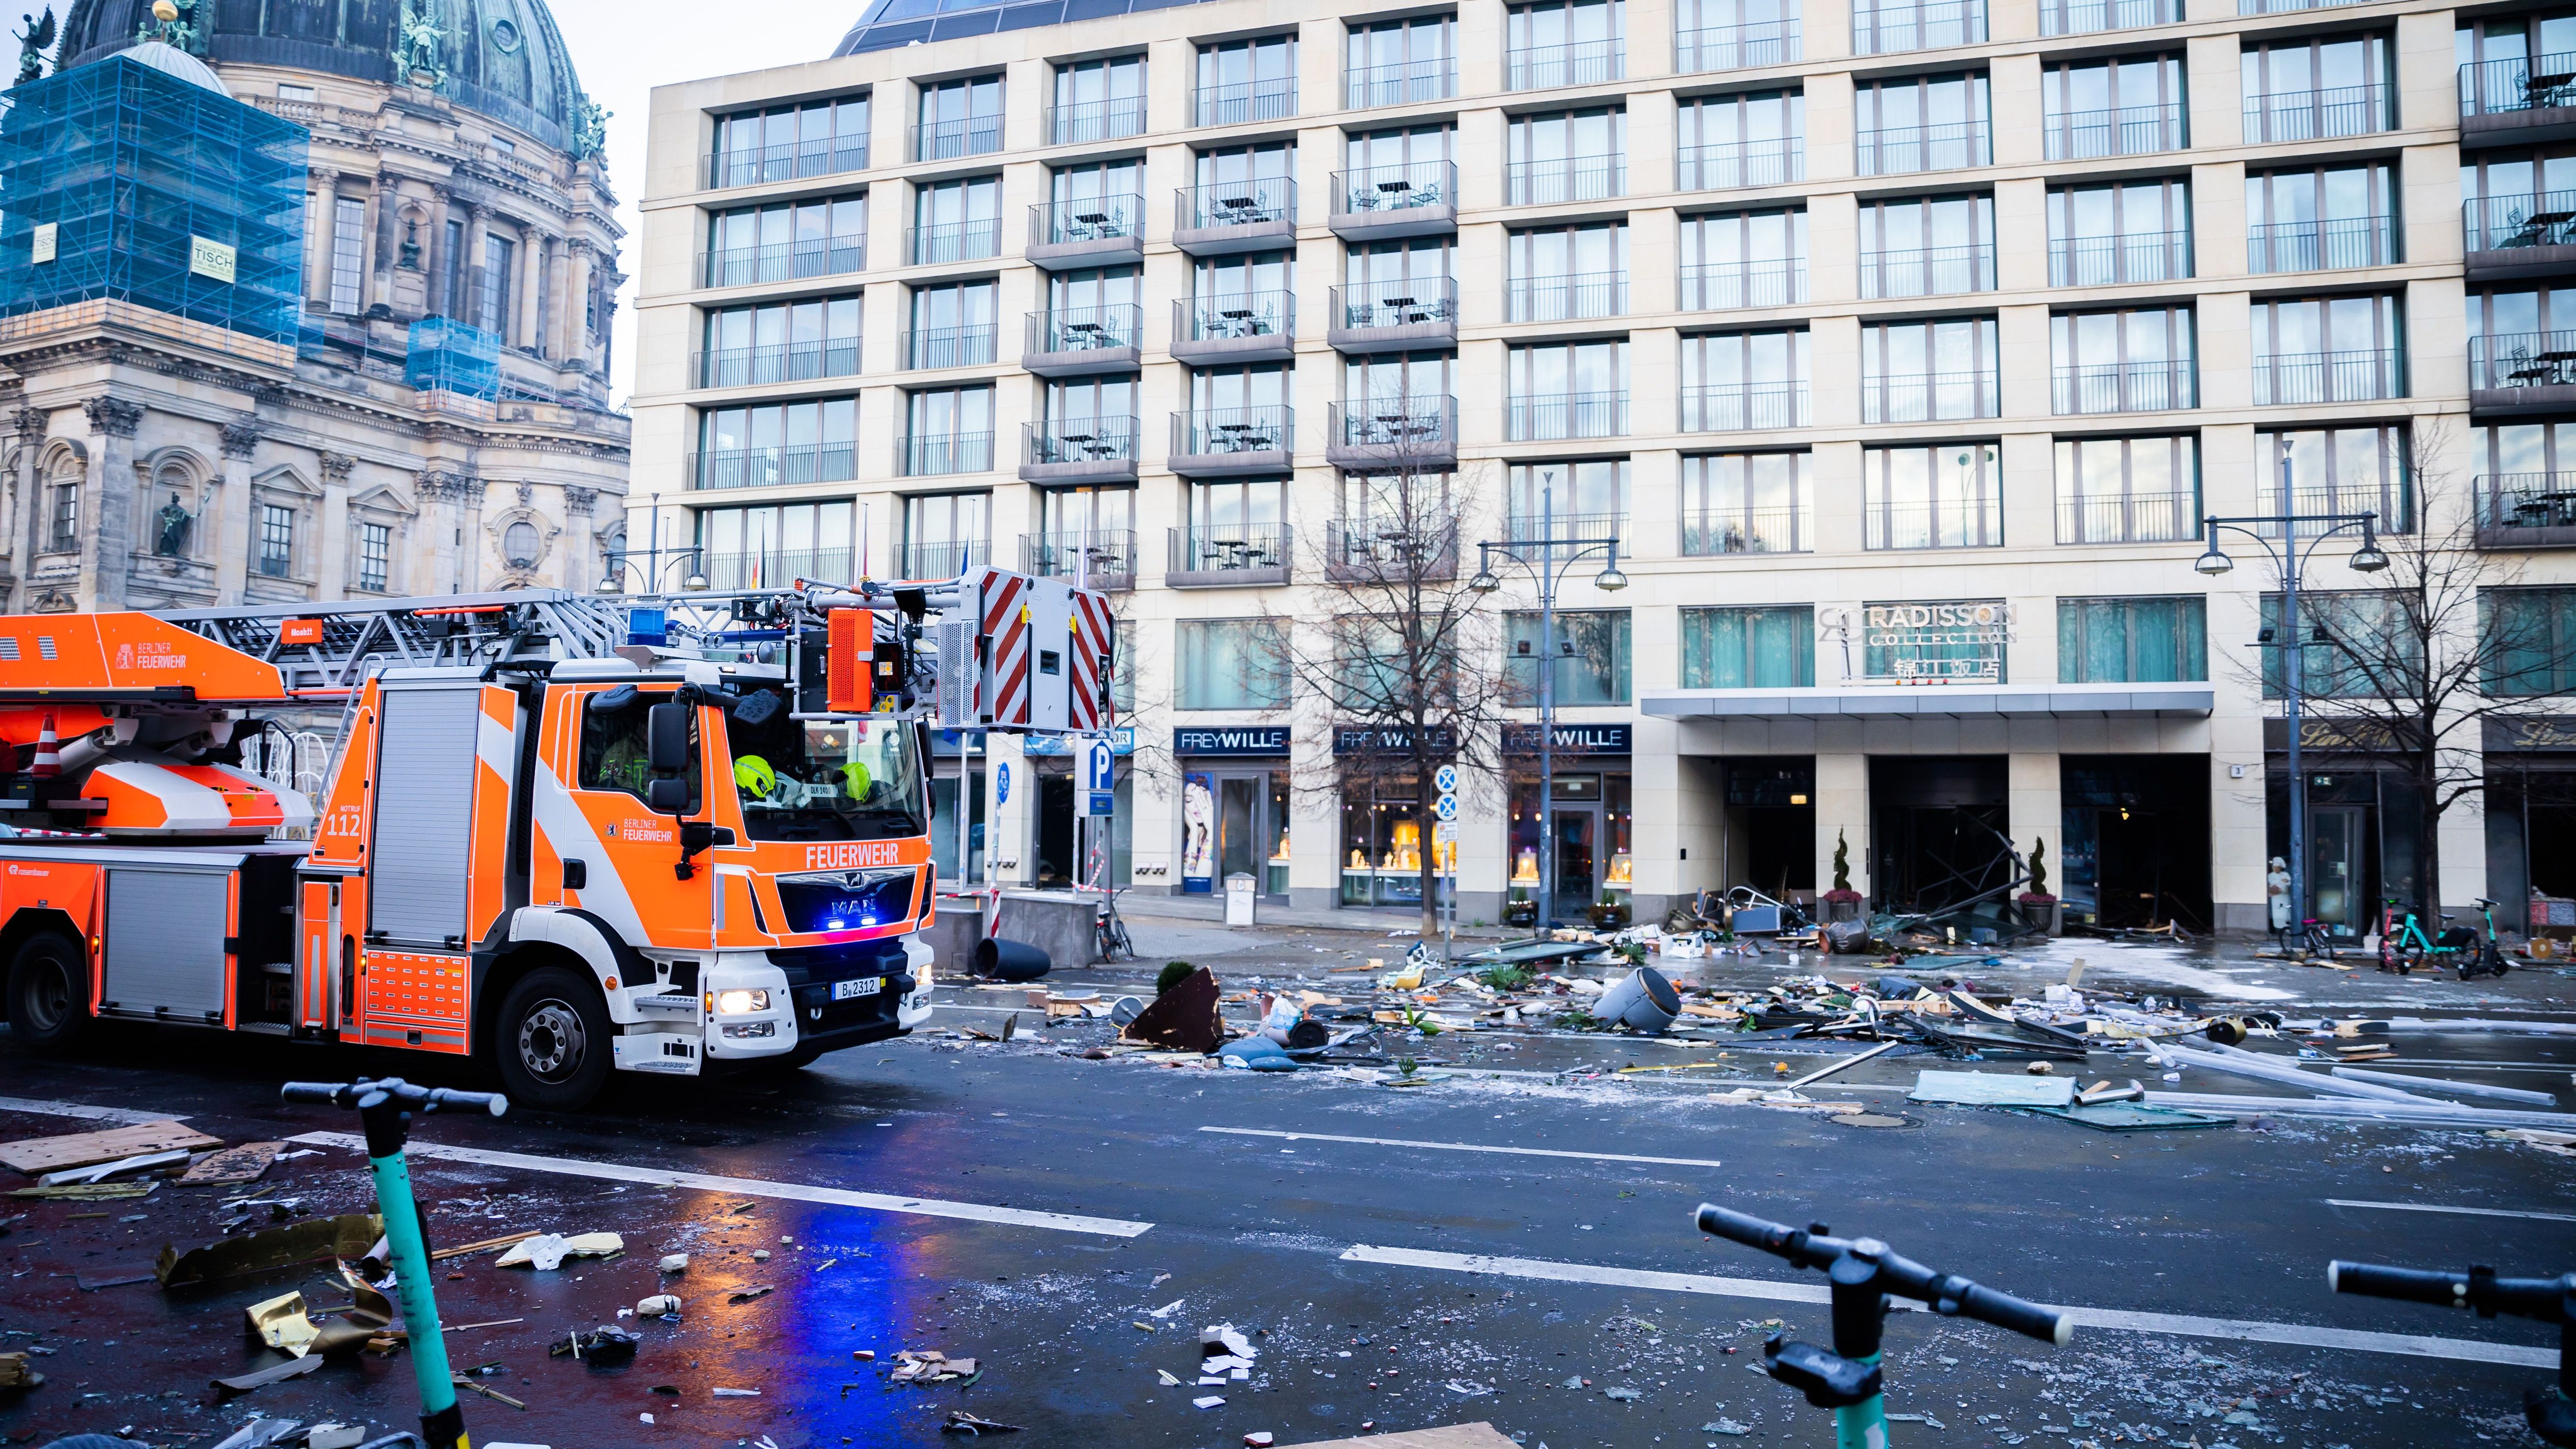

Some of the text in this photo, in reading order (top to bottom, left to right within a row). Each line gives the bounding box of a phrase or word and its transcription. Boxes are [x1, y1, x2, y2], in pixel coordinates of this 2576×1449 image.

[195, 248, 232, 268] TISCH
[1870, 604, 2017, 628] RADISSON
[291, 627, 313, 637] Moabit
[1869, 632, 2018, 647] COLLECTION
[138, 643, 171, 654] BERLINER
[137, 655, 186, 669] FEUERWEHR
[1893, 658, 2000, 679] 锦江饭店
[1181, 732, 1282, 748] FREYWILLE
[1510, 730, 1622, 746] FREWILLE
[1096, 745, 1110, 789] P
[327, 814, 360, 836] 112
[624, 819, 657, 829] BERLINER
[623, 829, 672, 842] FEUERWEHR
[806, 843, 899, 869] FEUERWEHR
[832, 898, 876, 915] MAN
[842, 979, 874, 997] B 2312
